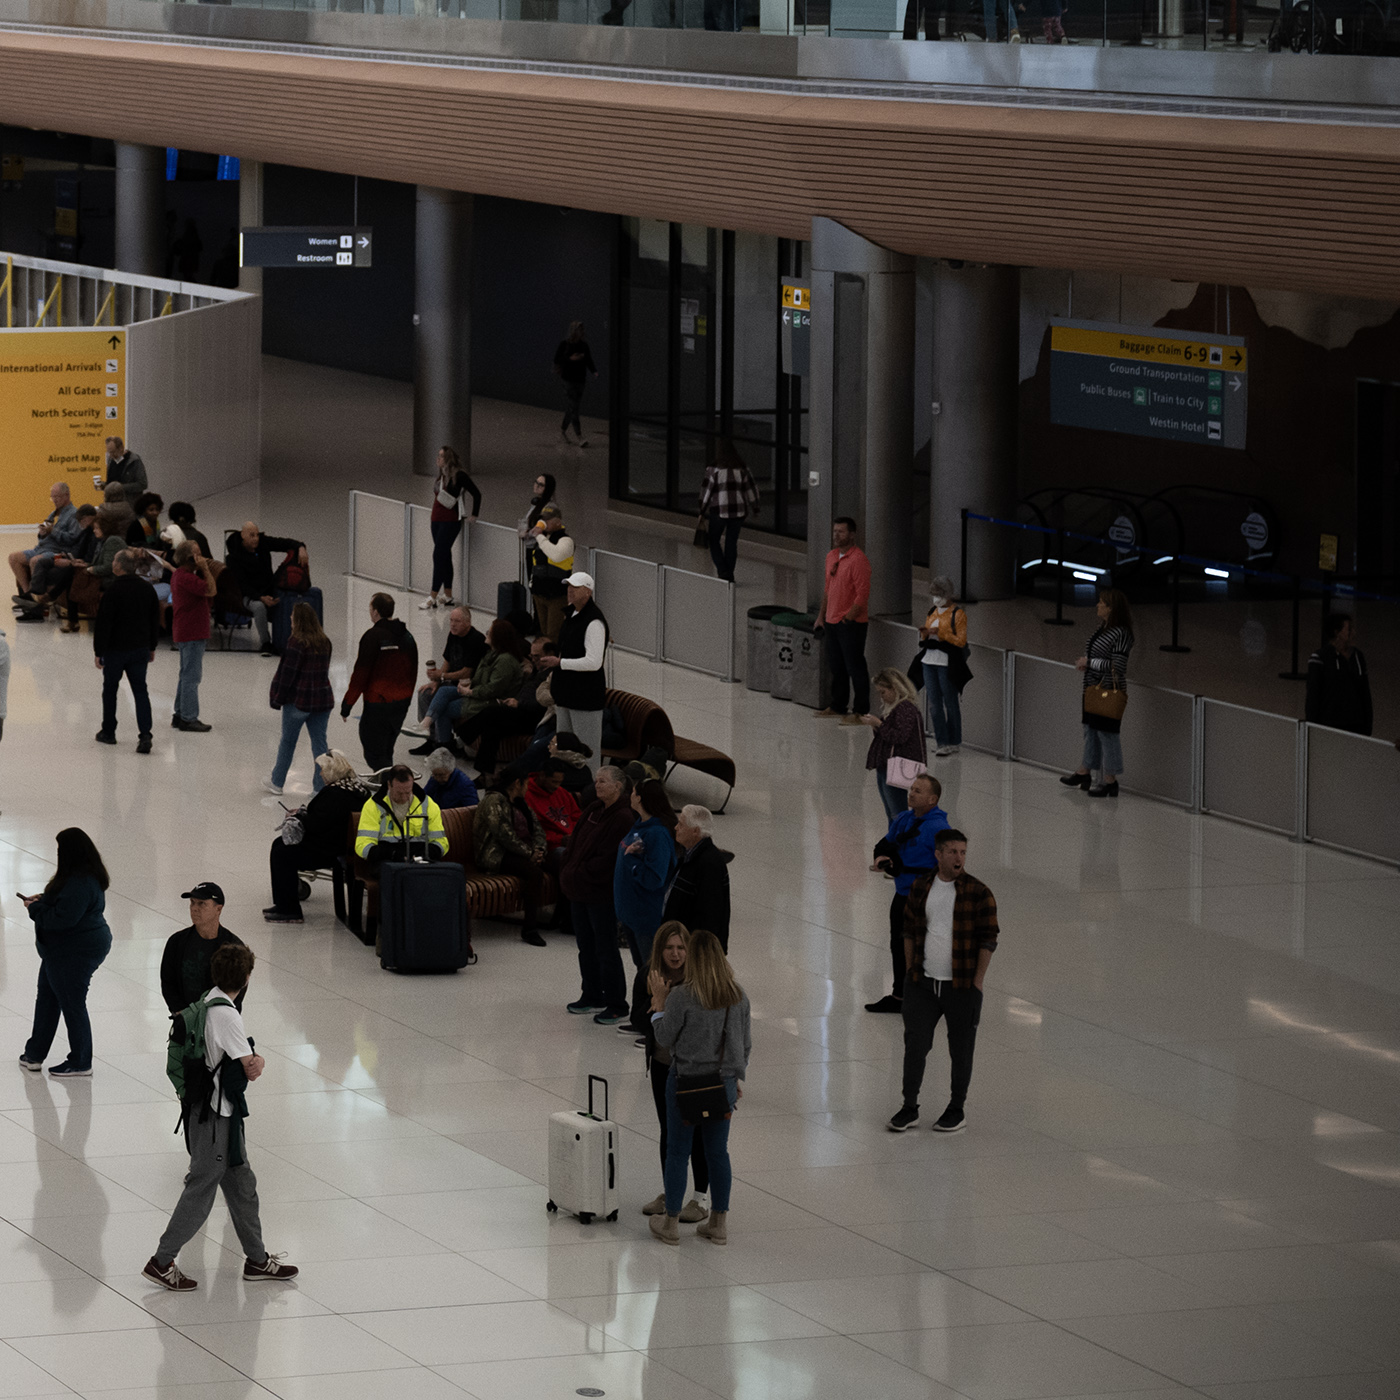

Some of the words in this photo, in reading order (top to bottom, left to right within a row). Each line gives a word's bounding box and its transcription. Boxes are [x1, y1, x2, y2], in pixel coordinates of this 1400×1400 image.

[308, 237, 338, 246] Women
[296, 254, 334, 262] Restroom
[1119, 340, 1155, 355] Baggage
[1157, 344, 1182, 356] Claim
[1184, 345, 1208, 362] 6-9
[0, 363, 63, 373] International
[66, 363, 102, 372] Arrivals
[1109, 362, 1141, 376] Ground
[1142, 366, 1206, 383] Transportation
[58, 386, 71, 395] All
[74, 386, 102, 395] Gates
[1080, 382, 1106, 396] Public
[1107, 386, 1132, 399] Buses
[1153, 392, 1174, 406] Train
[1176, 395, 1185, 406] to
[1187, 396, 1205, 410] City
[31, 409, 59, 418] North
[62, 408, 101, 419] Security
[1149, 416, 1180, 430] Westin
[1181, 420, 1205, 433] Hotel
[48, 455, 79, 464] Airport
[81, 454, 100, 463] Map
